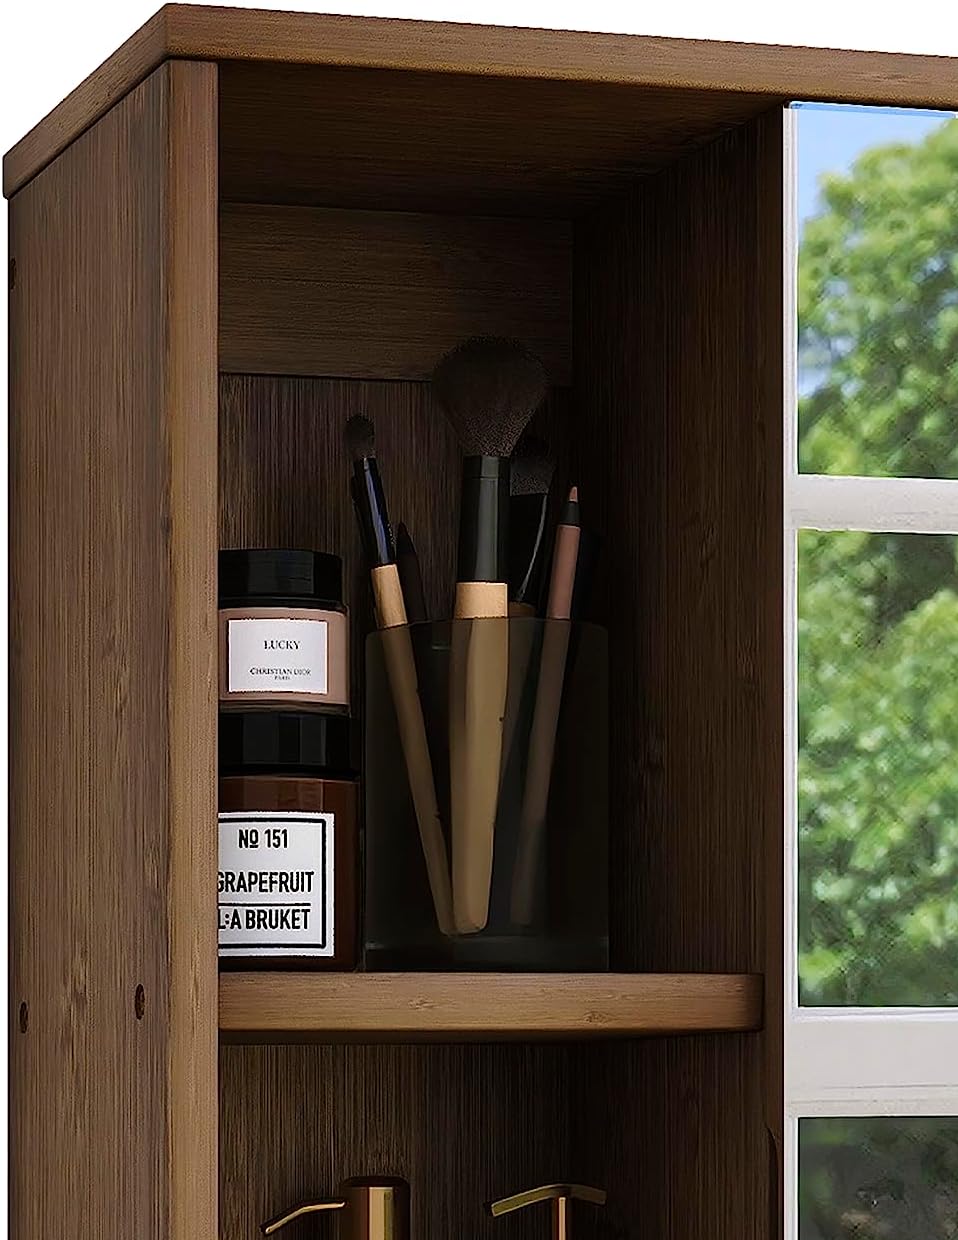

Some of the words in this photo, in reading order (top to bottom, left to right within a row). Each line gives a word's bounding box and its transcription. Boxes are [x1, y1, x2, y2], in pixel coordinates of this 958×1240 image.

[264, 640, 300, 650] LUCKY
[249, 667, 292, 675] CHRISTIAN
[264, 829, 288, 848] 151
[218, 871, 314, 893] GRAPEFRUIT
[245, 909, 311, 930] BRUKET
